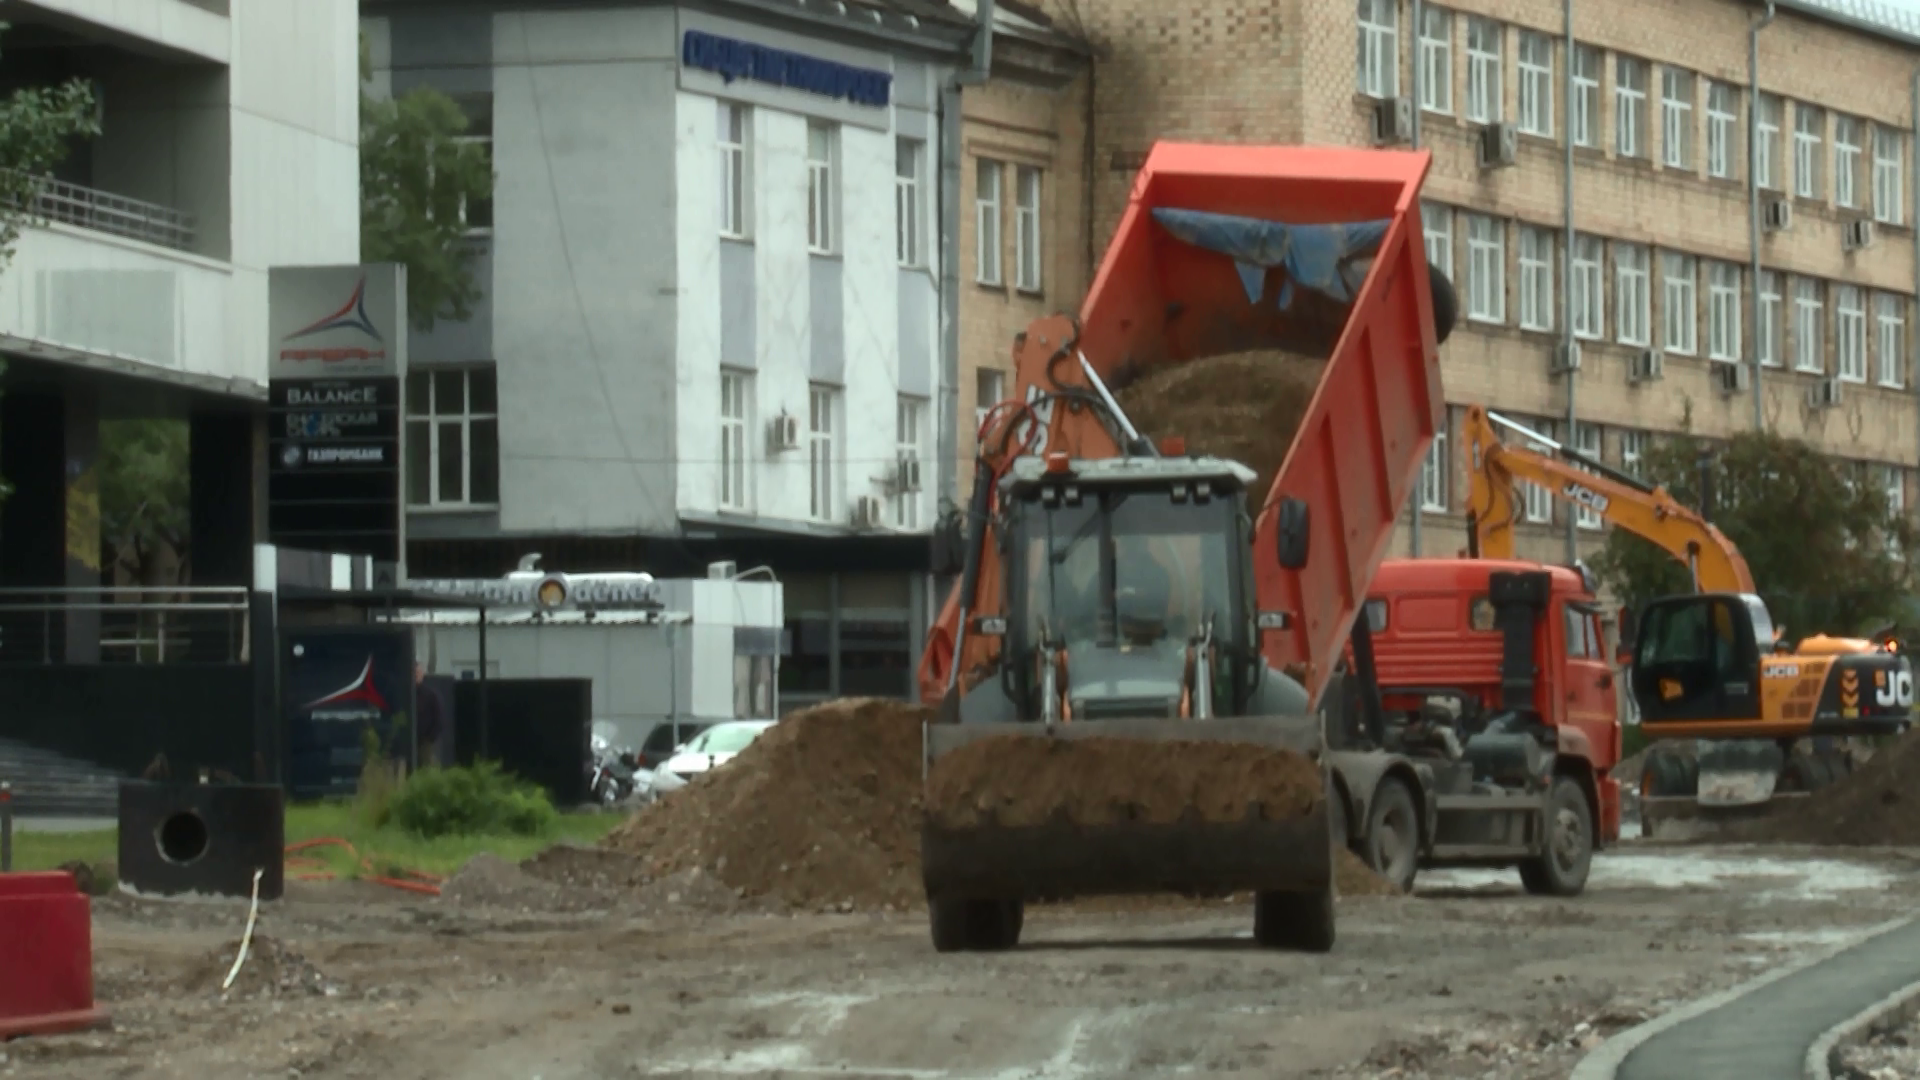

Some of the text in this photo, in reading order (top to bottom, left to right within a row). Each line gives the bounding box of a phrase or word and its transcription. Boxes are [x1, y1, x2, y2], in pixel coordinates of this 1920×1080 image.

[287, 386, 378, 405] BALANCE
[1563, 483, 1608, 512] JCB
[1762, 664, 1799, 678] JCB
[1876, 670, 1913, 707] JC
